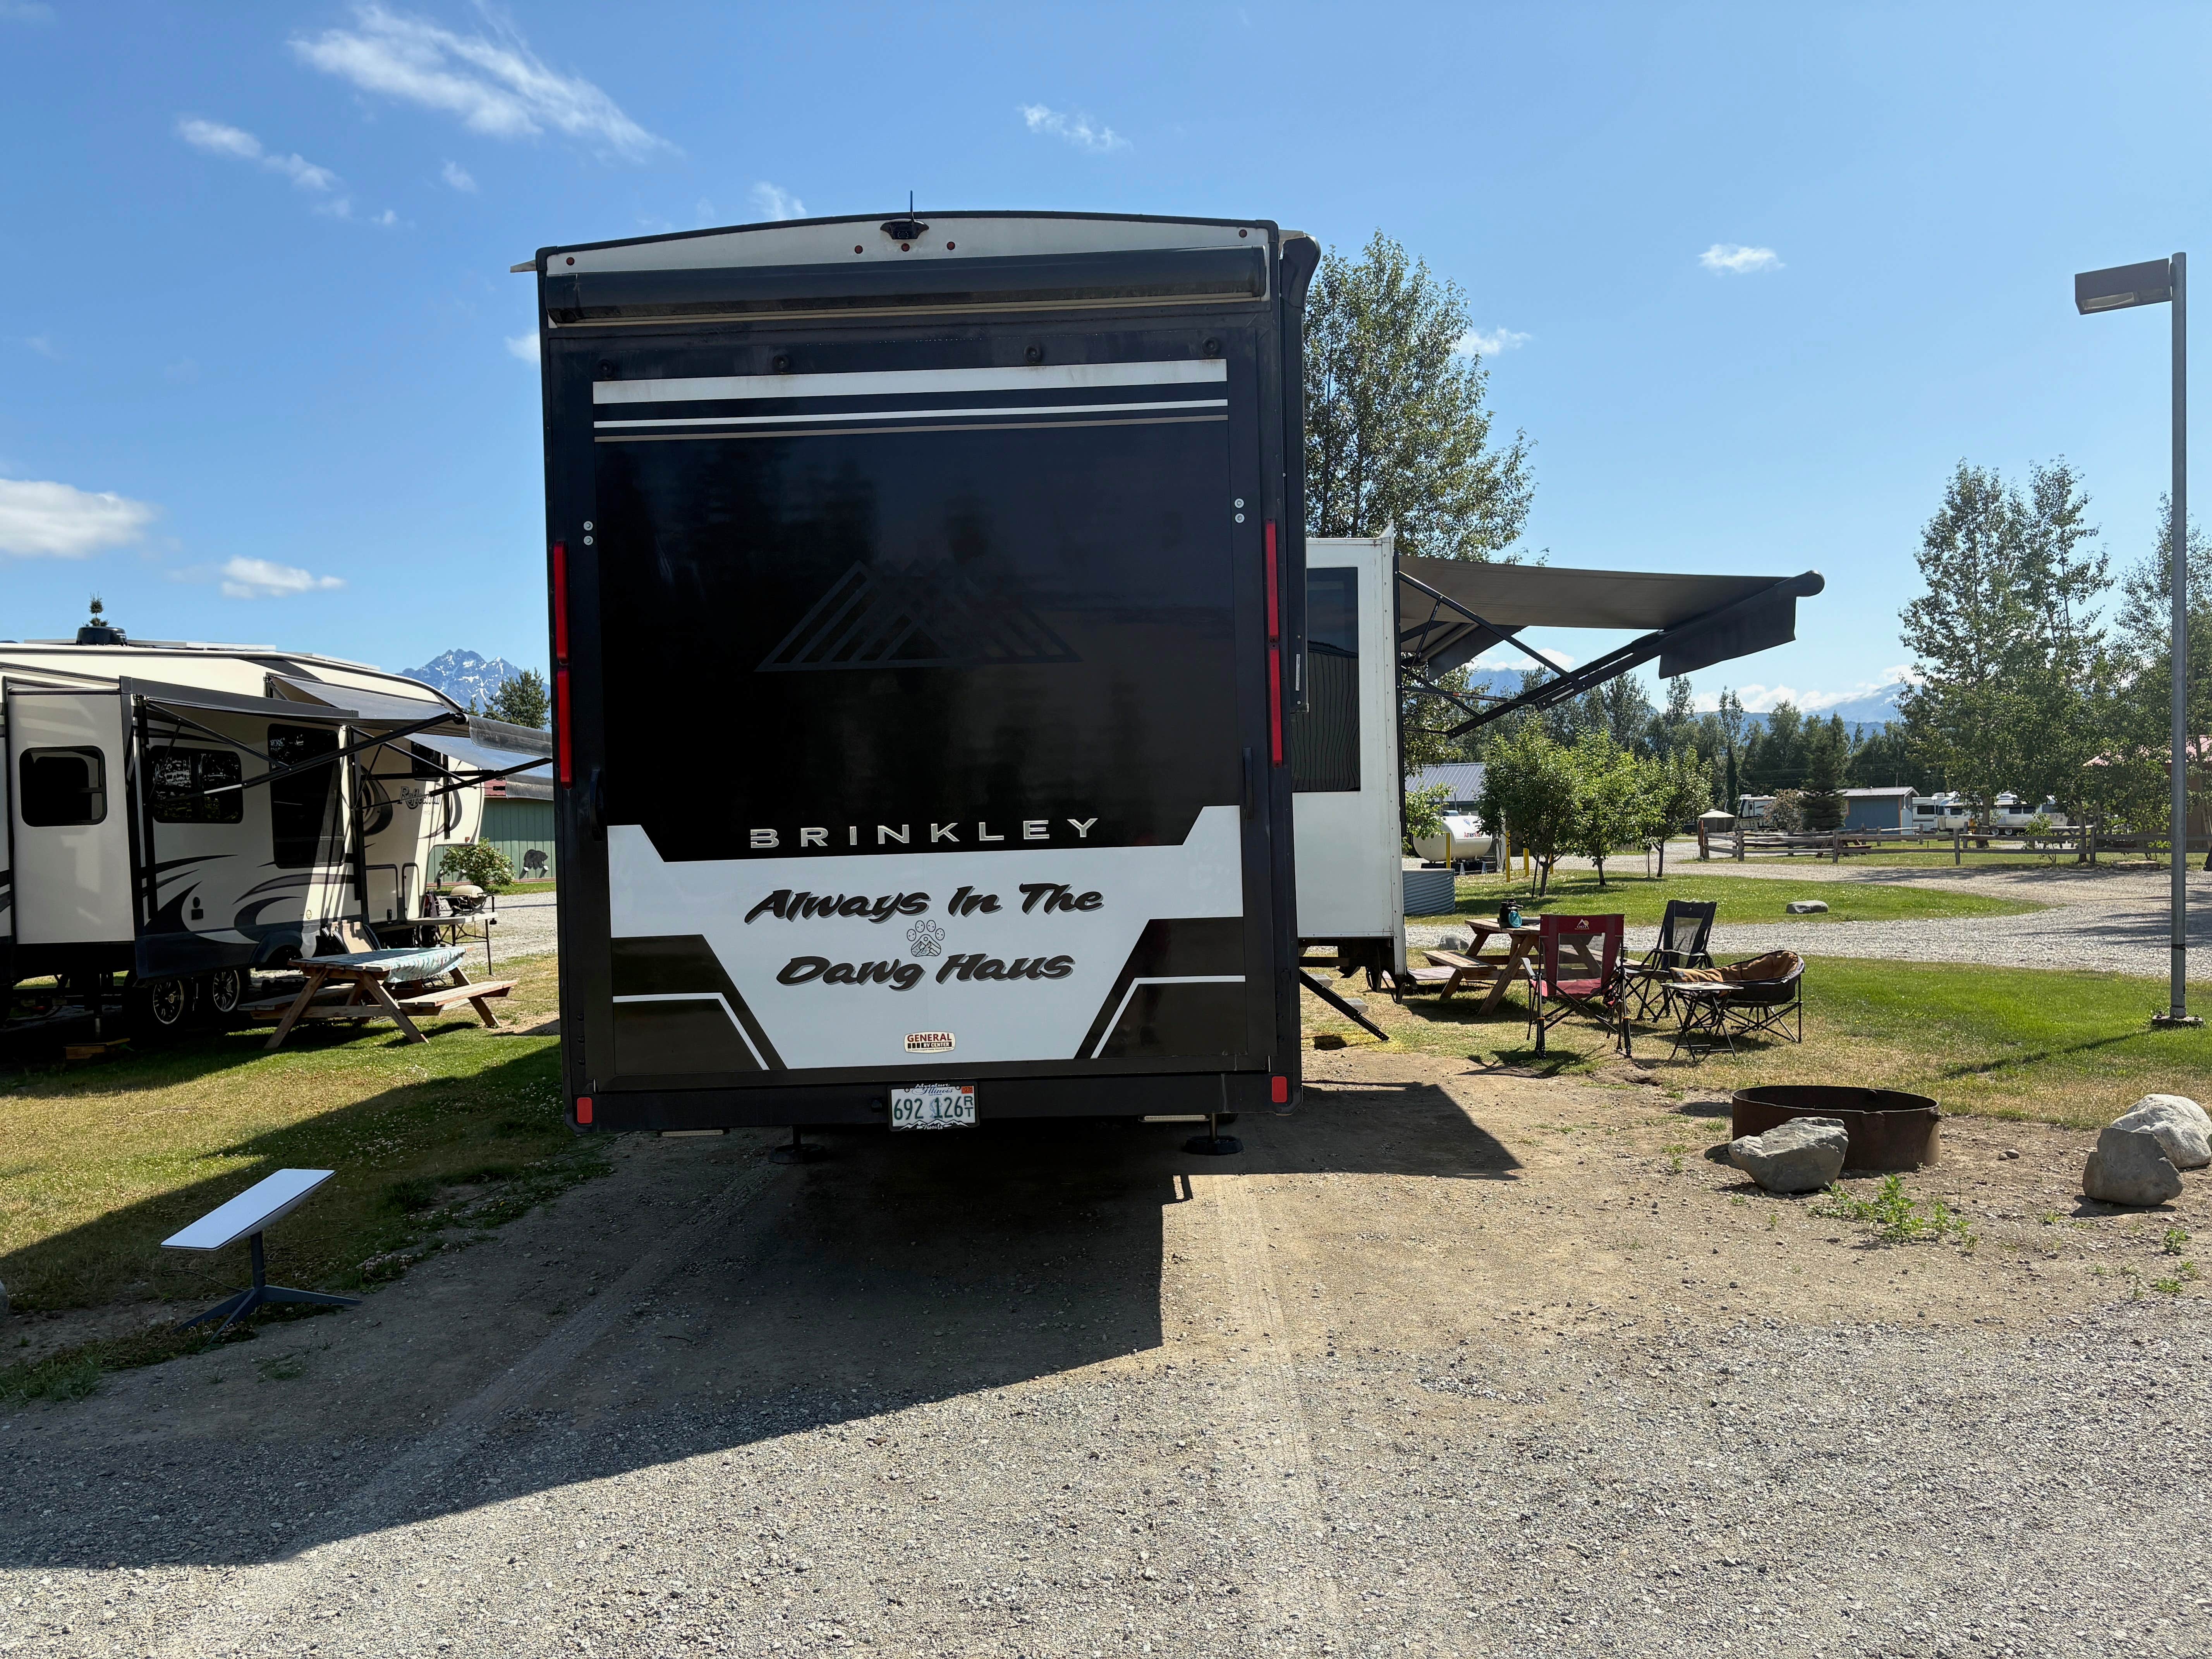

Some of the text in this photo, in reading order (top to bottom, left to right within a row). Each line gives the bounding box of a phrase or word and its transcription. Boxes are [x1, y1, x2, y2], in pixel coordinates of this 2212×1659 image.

[750, 817, 1098, 848] BRINKLEY
[744, 883, 1105, 924] Always In The
[776, 953, 1075, 991] Dawg Haus
[907, 1033, 952, 1042] GENERAL
[912, 1087, 954, 1095] Illinois
[894, 1096, 963, 1120] 692 126
